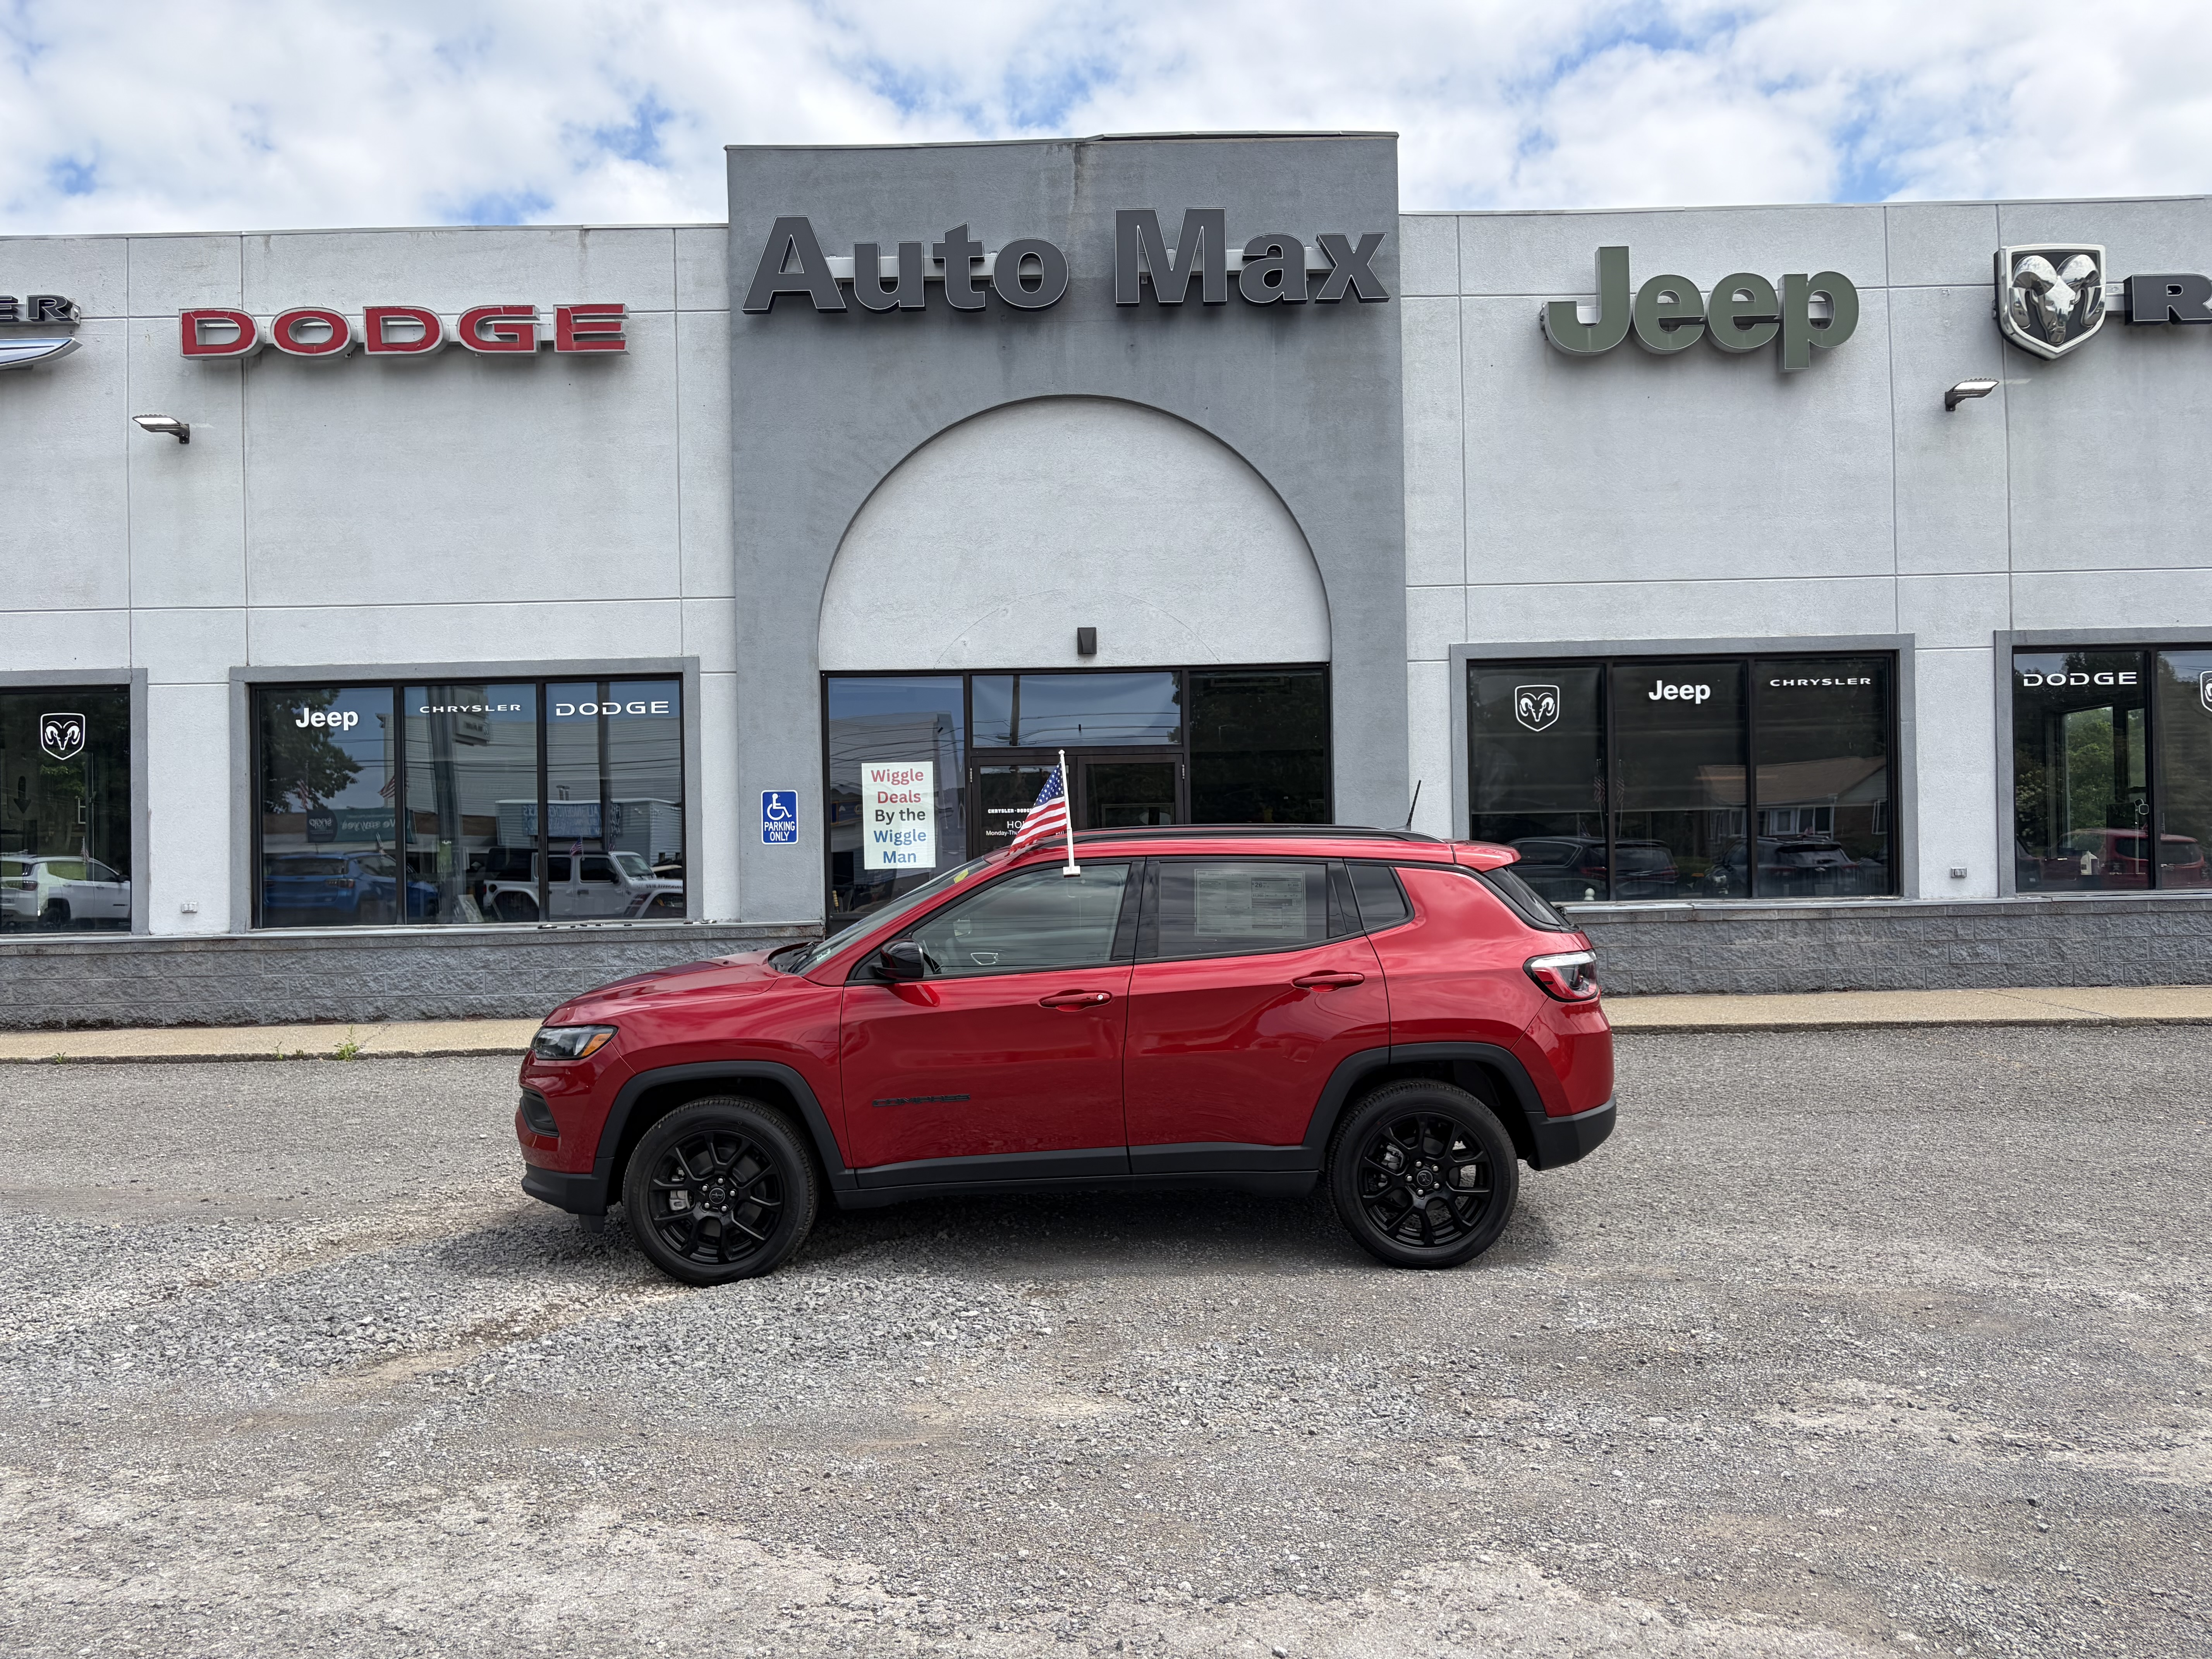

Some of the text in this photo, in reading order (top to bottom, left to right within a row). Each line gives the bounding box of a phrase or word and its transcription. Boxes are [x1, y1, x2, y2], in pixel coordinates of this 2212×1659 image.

[742, 207, 1391, 314] Auto Max
[1544, 246, 1860, 373] Jeep
[179, 304, 630, 359] DODGE
[1770, 678, 1871, 687] CHRYSLER
[2023, 672, 2137, 686] DODGE
[1648, 680, 1711, 704] Jeep
[419, 704, 521, 713] CHRYSLER
[556, 701, 669, 716] DODGE
[295, 708, 358, 731] Jeep
[871, 768, 924, 785] Wiggle
[878, 790, 921, 804] Deals
[875, 808, 926, 825] By the
[764, 821, 795, 831] PARKING
[770, 831, 790, 841] ONLY
[874, 829, 927, 846] Wiggle
[883, 851, 917, 863] Man
